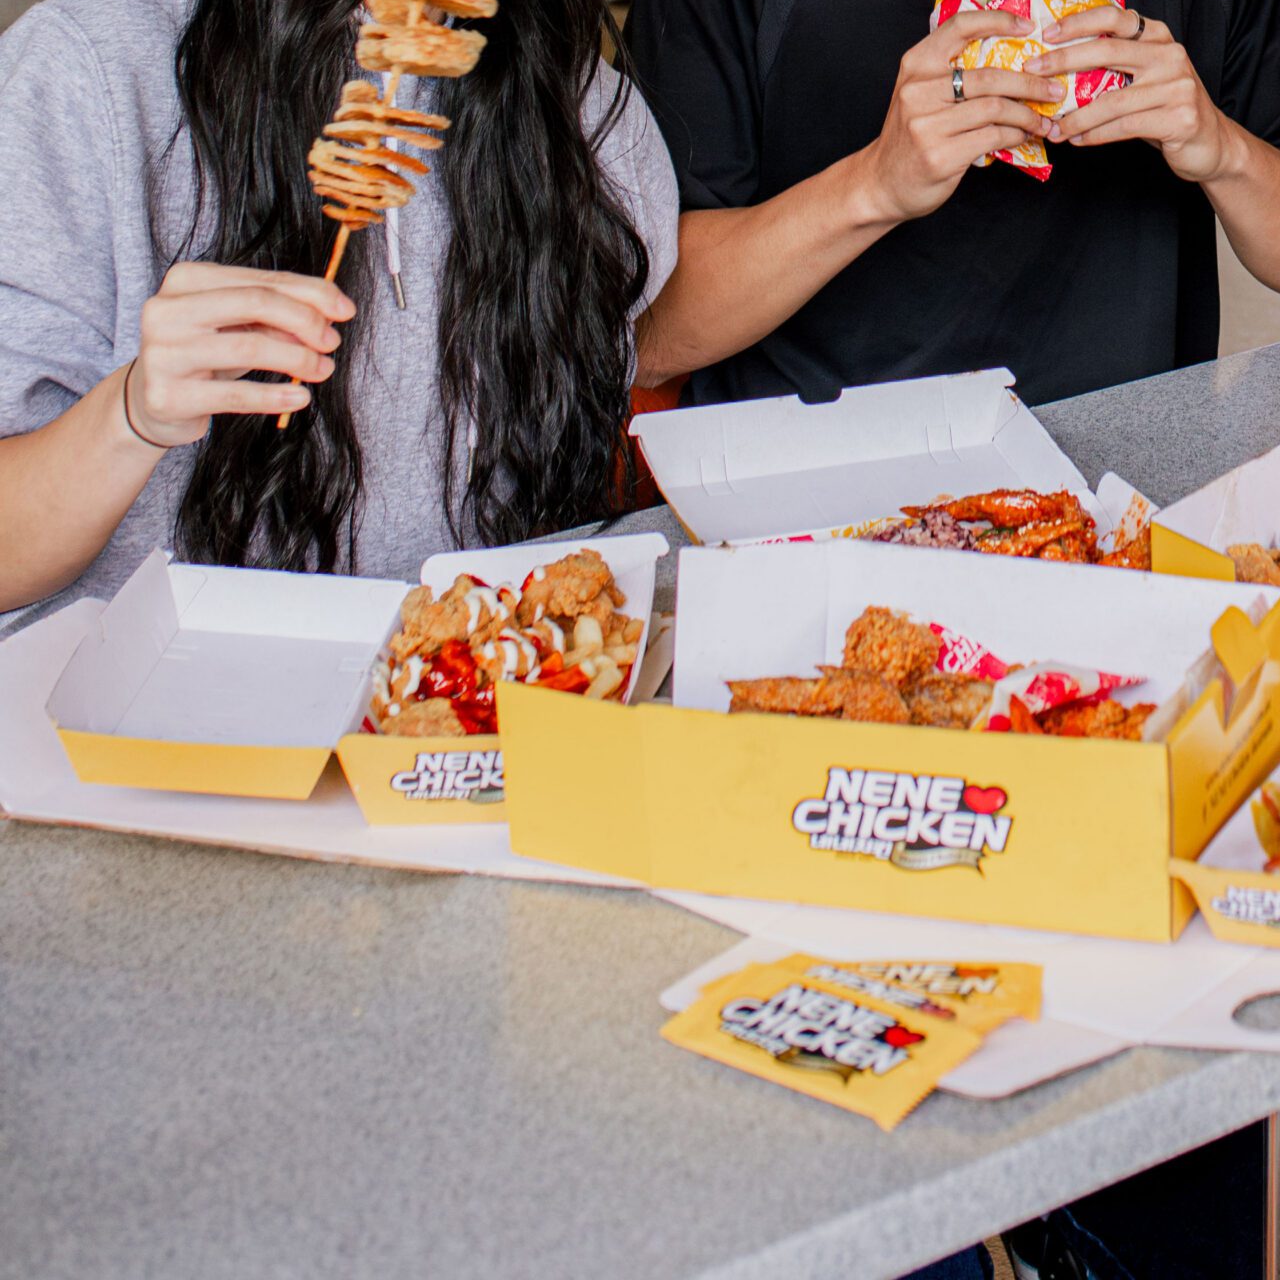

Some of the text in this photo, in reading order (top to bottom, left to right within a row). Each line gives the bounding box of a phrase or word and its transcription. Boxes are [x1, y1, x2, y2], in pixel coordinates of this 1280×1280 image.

[390, 770, 504, 794] CHICK
[823, 766, 965, 813] NENE
[791, 798, 1013, 853] CHICKEN
[720, 997, 910, 1075] CHICKEN
[764, 983, 899, 1041] NENE
